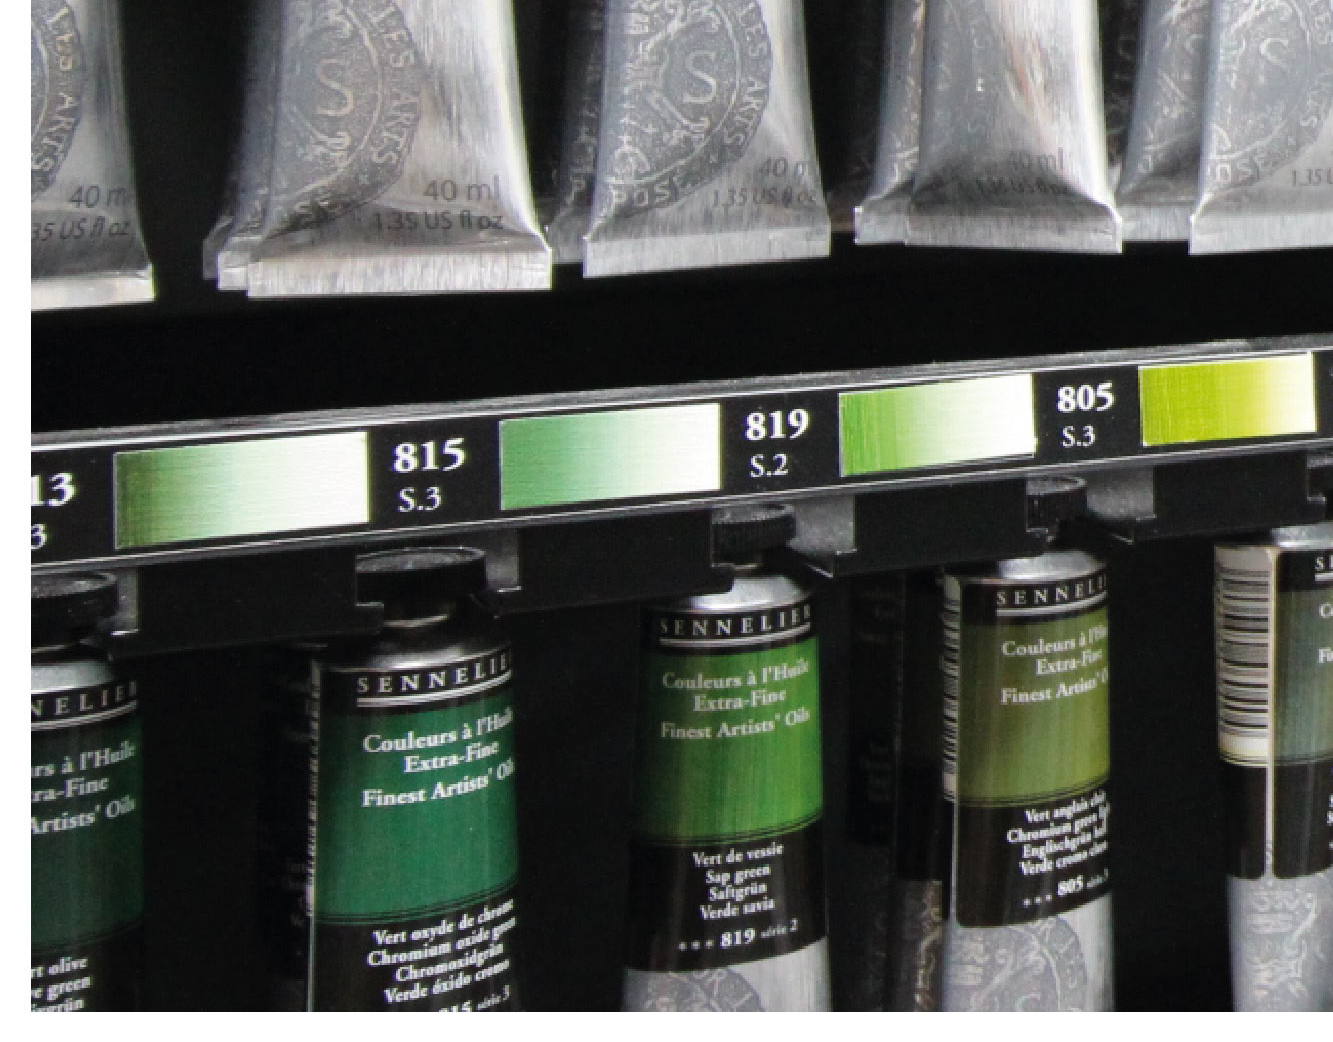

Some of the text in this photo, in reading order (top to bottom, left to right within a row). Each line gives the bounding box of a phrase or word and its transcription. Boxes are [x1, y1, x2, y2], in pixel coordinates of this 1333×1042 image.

[68, 186, 100, 208] 40
[424, 174, 499, 201] 40 ml
[425, 211, 453, 230] US
[1056, 383, 1115, 413] 805
[745, 409, 810, 441] 819
[1062, 426, 1095, 448] S.3
[392, 438, 466, 473] 815
[750, 454, 788, 479] S.2
[399, 487, 442, 512] S.3
[1002, 639, 1075, 656] Couleurs
[663, 671, 756, 689] Couleurs à
[693, 689, 786, 712] Extra-Fine
[1002, 687, 1050, 705] Finest
[363, 723, 472, 752] Couleurs à
[661, 713, 780, 739] Finest Artists'
[62, 756, 73, 774] à
[404, 741, 499, 773] Extra-Fine
[362, 768, 492, 806] Finest Artists'
[1025, 809, 1049, 823] Vert
[693, 842, 783, 867] Vert de vessie
[706, 864, 770, 885] Sap green
[1058, 875, 1083, 895] 805
[700, 902, 739, 920] Verde
[373, 930, 406, 945] Vert
[459, 914, 474, 929] de
[721, 928, 755, 948] 819
[49, 957, 87, 974] olive
[367, 942, 451, 966] Chromium
[47, 976, 90, 1001] green
[385, 983, 428, 1003] Verde
